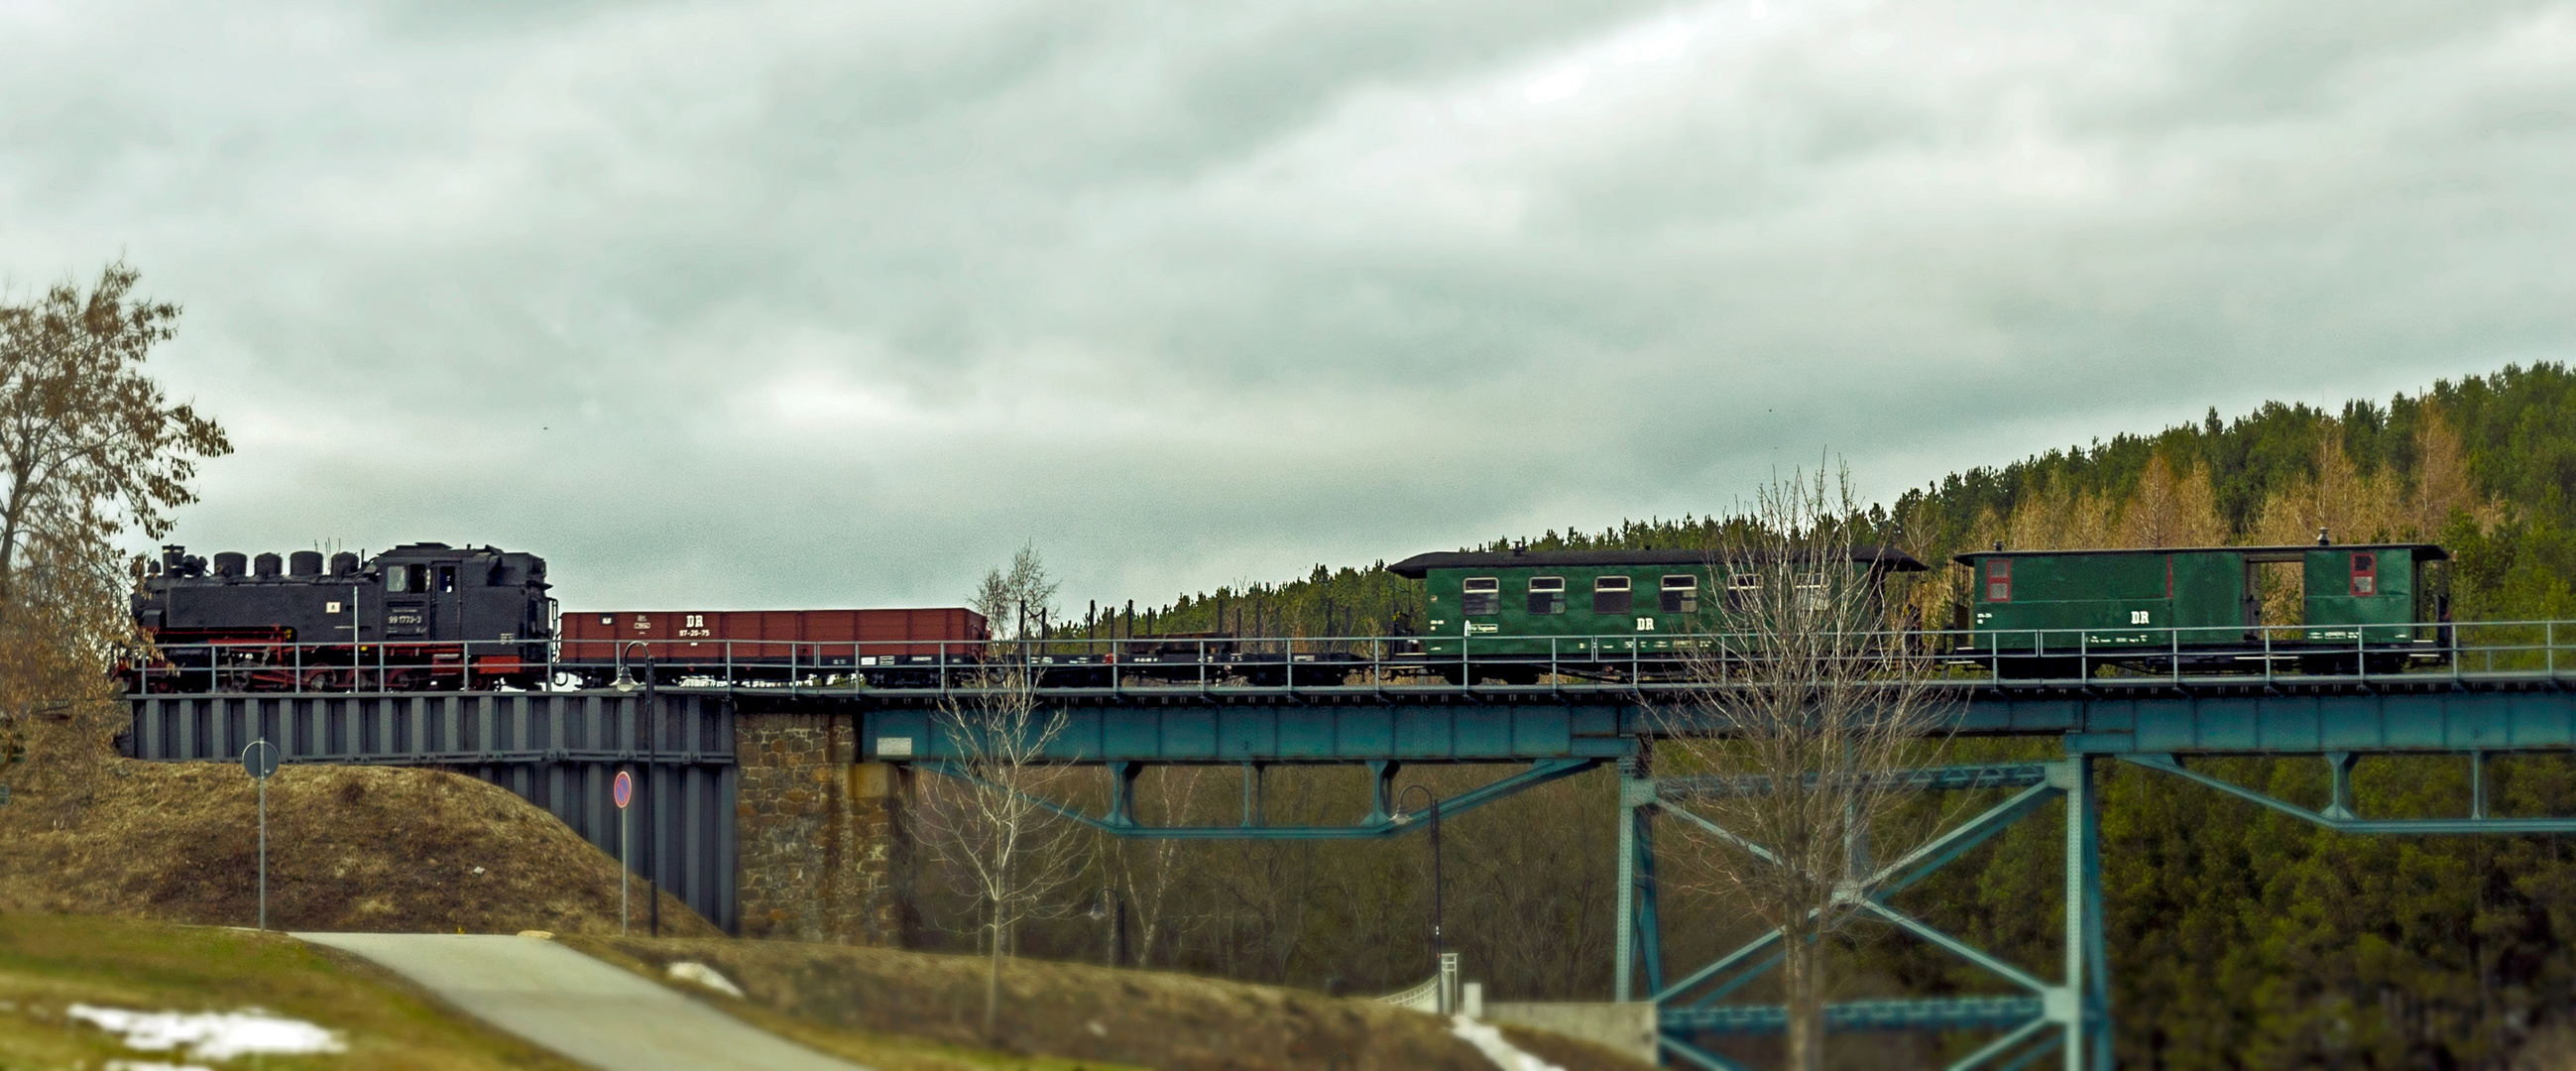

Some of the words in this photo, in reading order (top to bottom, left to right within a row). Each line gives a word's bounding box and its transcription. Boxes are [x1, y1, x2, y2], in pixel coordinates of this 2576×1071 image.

[686, 615, 704, 628] DR
[1636, 617, 1655, 631] DR
[2131, 611, 2150, 625] DR
